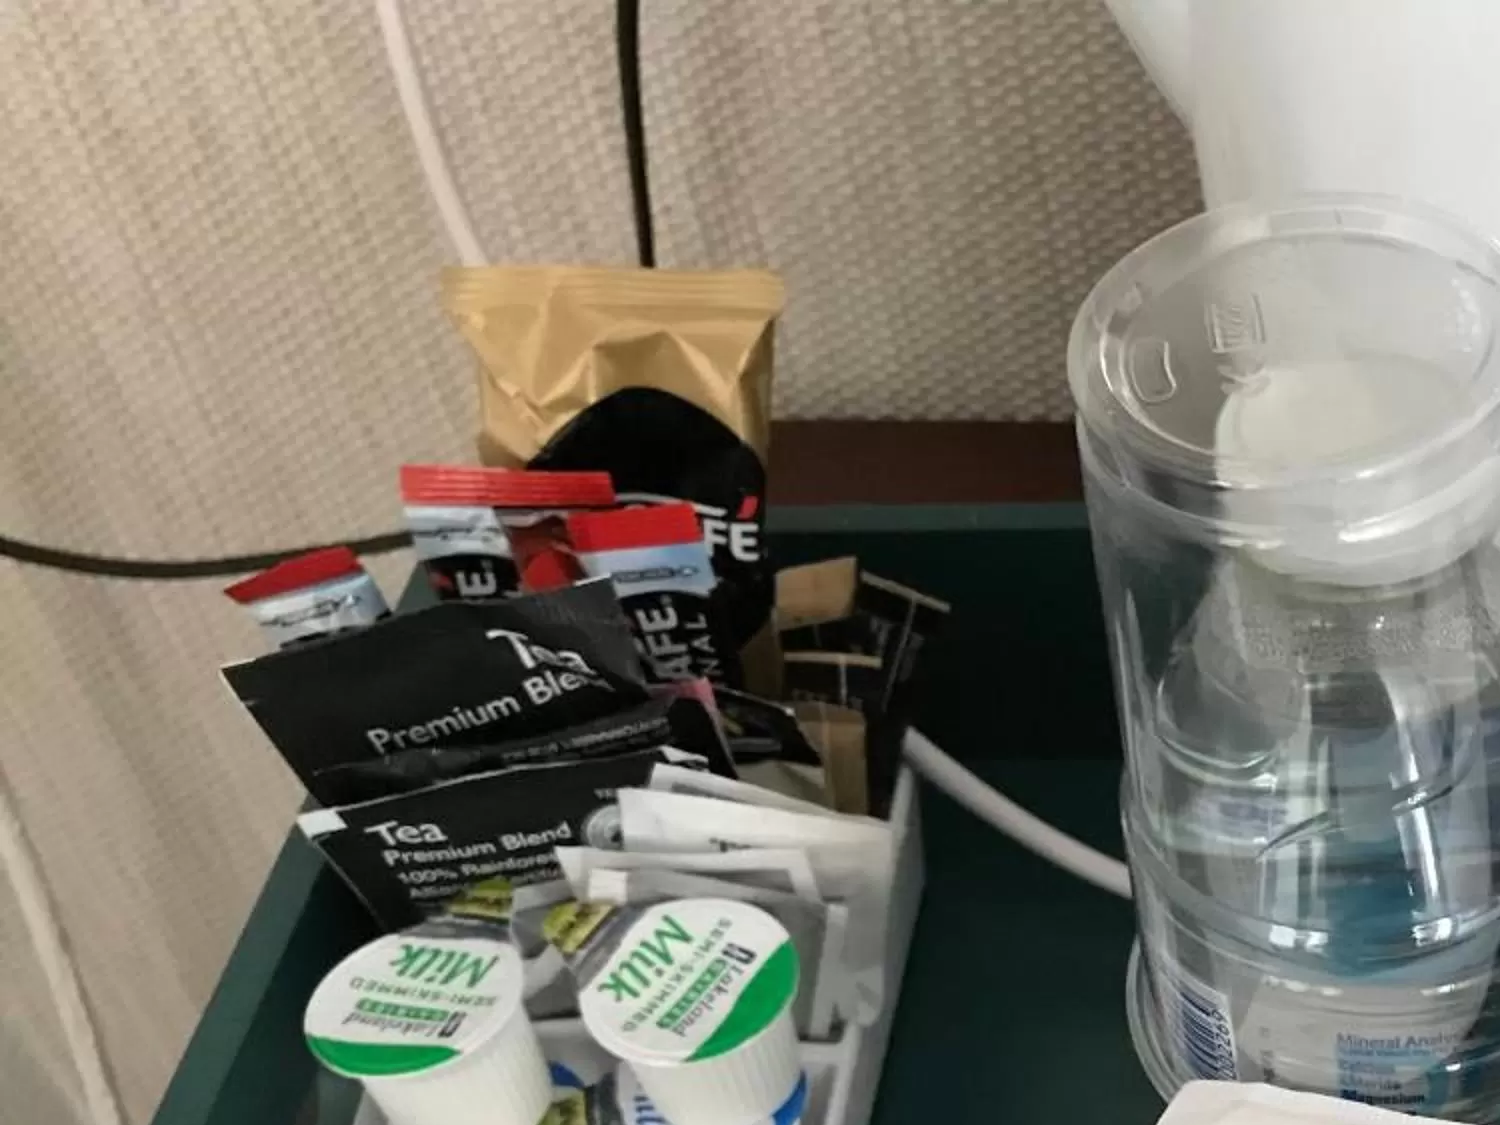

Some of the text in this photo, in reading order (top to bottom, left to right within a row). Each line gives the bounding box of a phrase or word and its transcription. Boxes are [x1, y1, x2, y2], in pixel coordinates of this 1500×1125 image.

[366, 695, 521, 755] Premium
[364, 821, 448, 847] Tea
[381, 820, 572, 867] Premium Blend
[389, 944, 500, 988] Milk
[597, 913, 694, 1003] Milk
